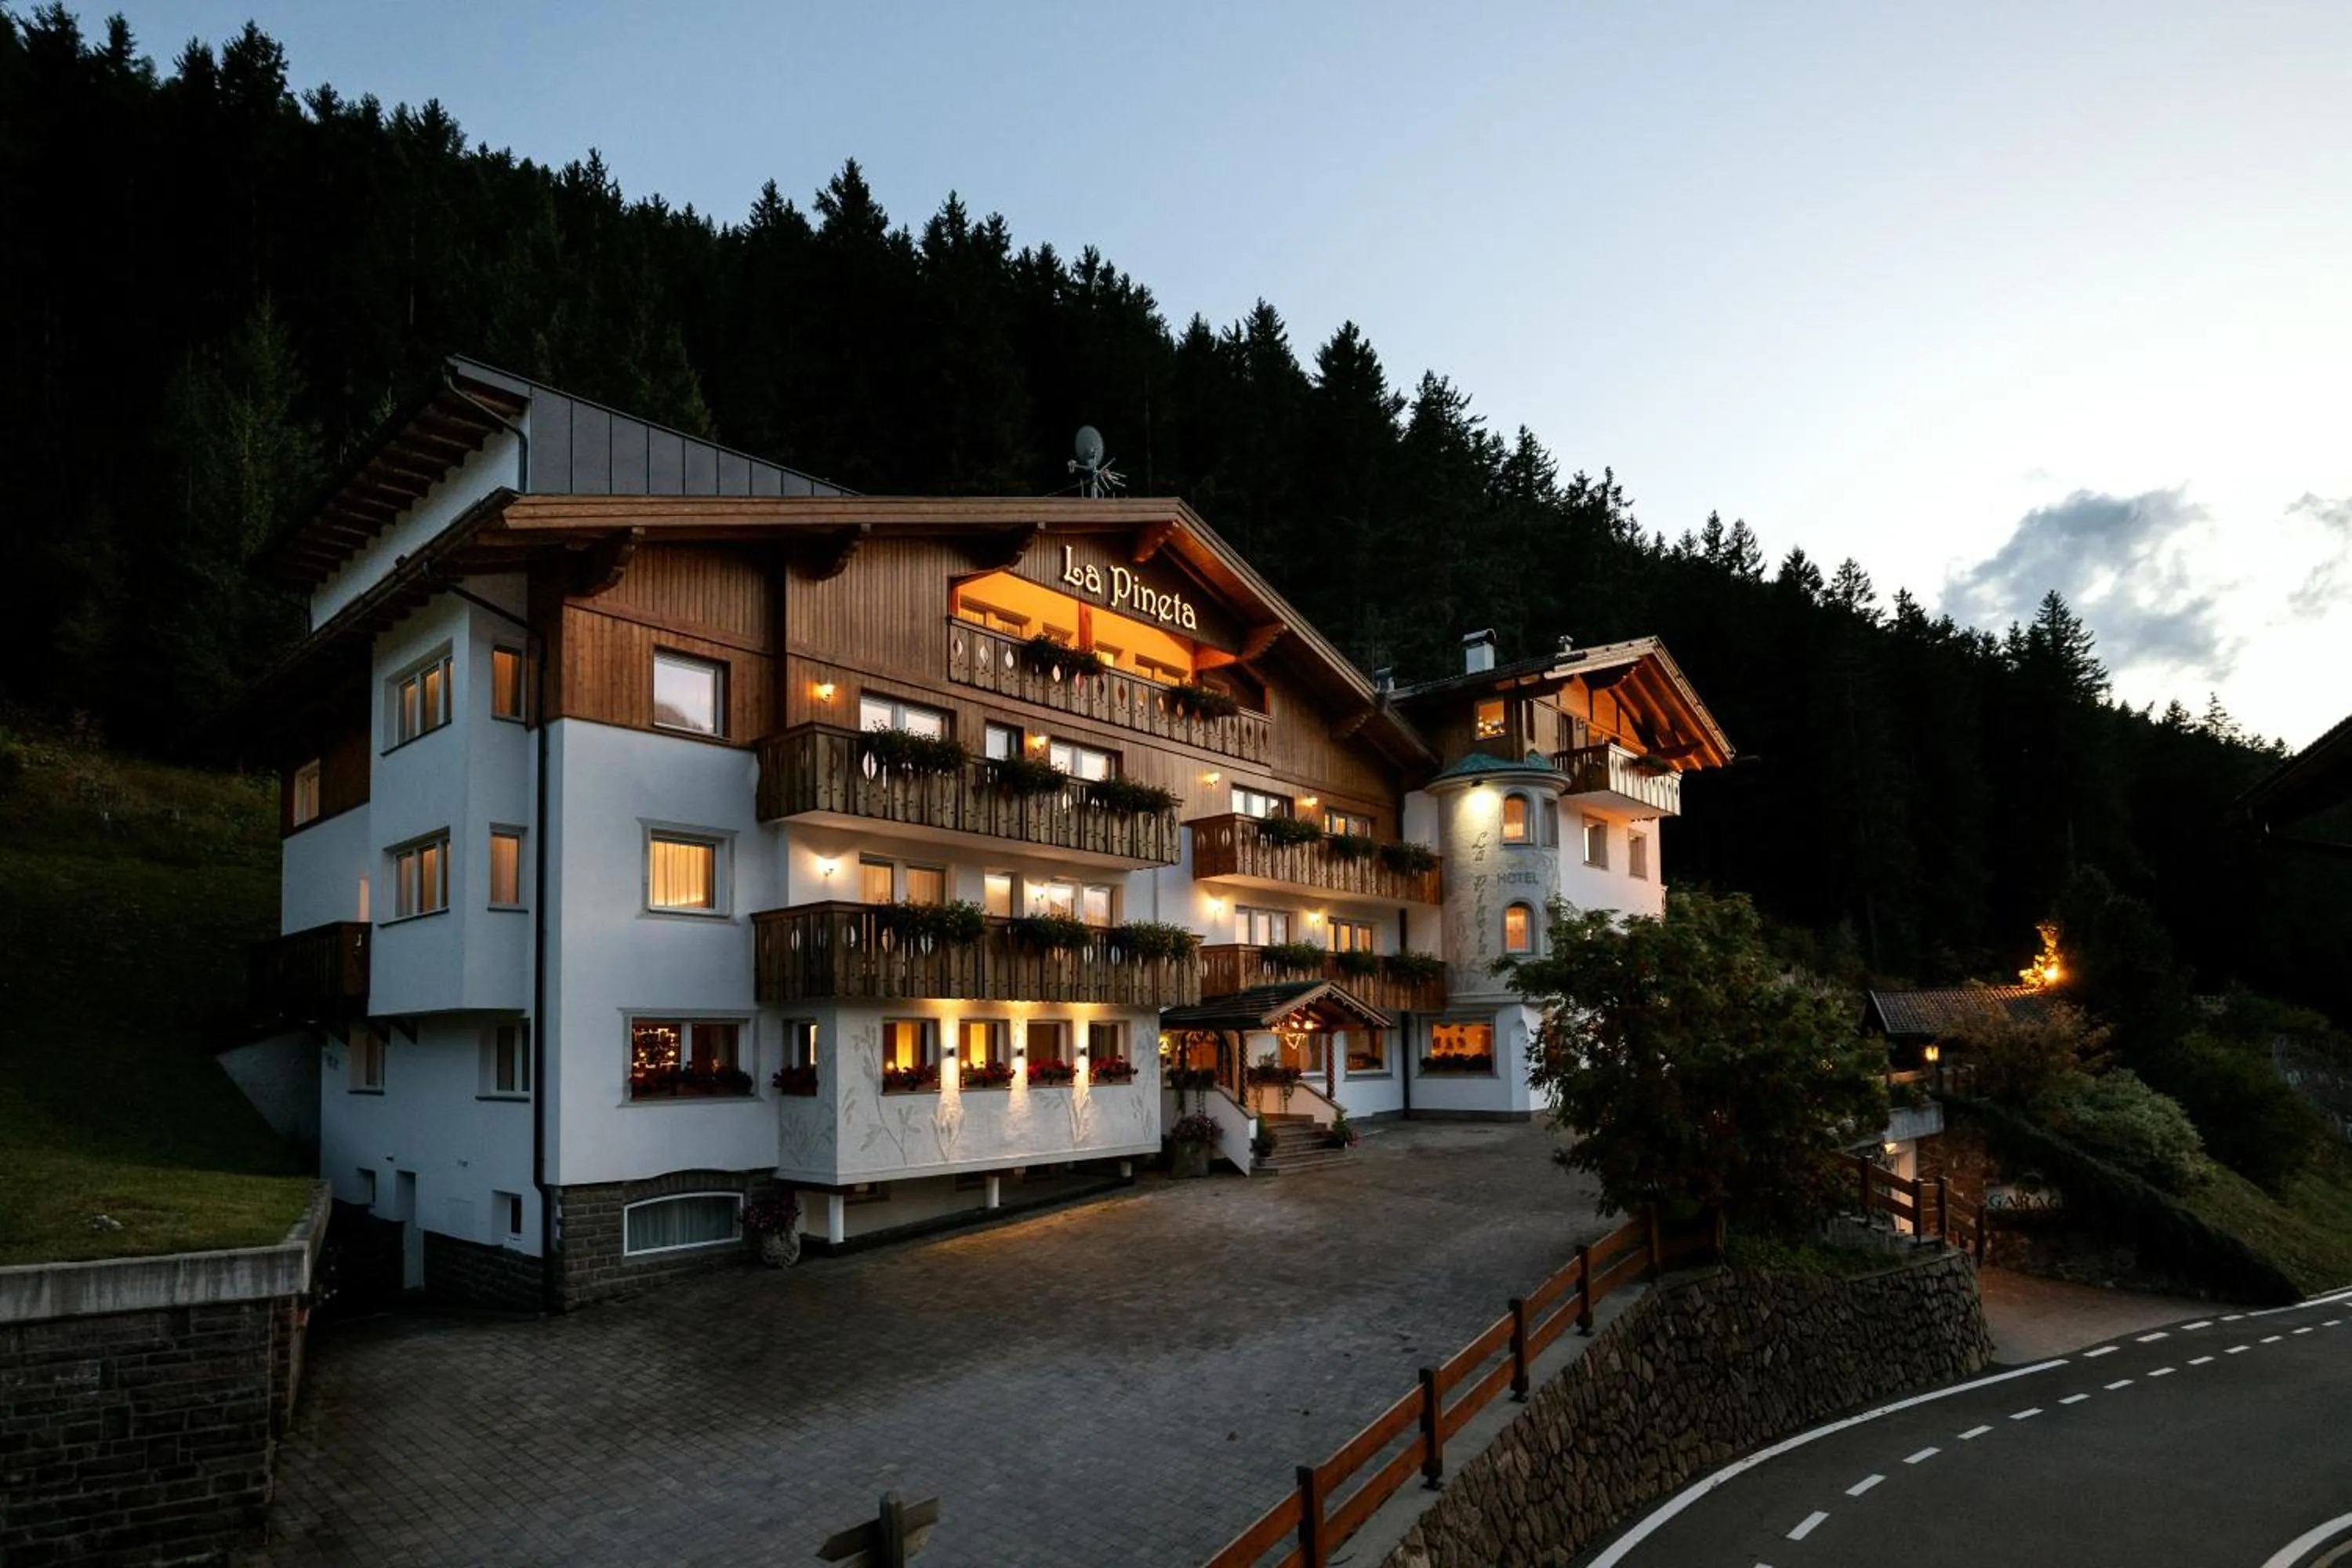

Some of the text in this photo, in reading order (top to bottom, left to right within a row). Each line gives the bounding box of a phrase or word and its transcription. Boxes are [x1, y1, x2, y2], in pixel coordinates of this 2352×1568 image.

[1064, 545, 1197, 630] La Pineta
[1497, 871, 1540, 885] HOTEL
[1989, 1194, 2061, 1209] GARAG
